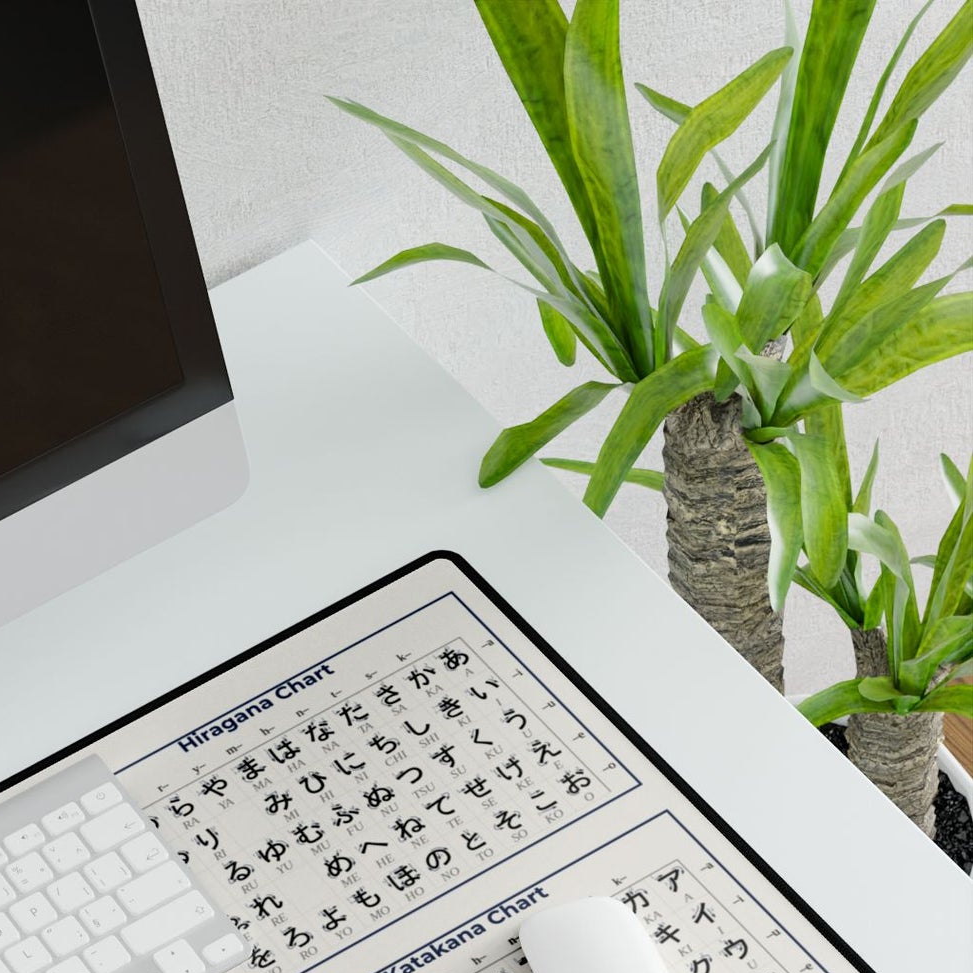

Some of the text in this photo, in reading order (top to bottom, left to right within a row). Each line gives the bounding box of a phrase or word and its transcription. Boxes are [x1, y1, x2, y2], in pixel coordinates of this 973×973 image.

[438, 648, 470, 670] あ
[407, 668, 436, 690] か
[376, 684, 402, 707] さ
[425, 684, 444, 698] KA
[470, 680, 499, 700] い
[177, 663, 336, 754] Hiragana Chart
[338, 704, 370, 727] た
[438, 698, 464, 718] き
[357, 722, 374, 734] TA
[403, 720, 431, 736] し
[503, 708, 527, 730] う
[304, 720, 335, 743] な
[418, 732, 440, 748] SHI
[470, 728, 494, 746] く
[267, 740, 301, 764] は
[321, 740, 340, 754] NA
[368, 735, 398, 755] ち
[531, 739, 562, 764] え
[287, 758, 306, 773] HA
[333, 752, 366, 776] に
[384, 750, 408, 767] CHI
[431, 745, 456, 768] す
[236, 757, 266, 780] ま
[396, 767, 423, 785] つ
[495, 758, 523, 781] け
[201, 778, 228, 797] や
[252, 776, 273, 791] MA
[298, 771, 327, 794] ひ
[411, 782, 436, 799] TSU
[463, 778, 492, 798] せ
[516, 776, 533, 791] KE
[560, 771, 591, 794] お
[169, 796, 195, 817] ら
[218, 798, 235, 811] YA
[264, 793, 293, 814] み
[319, 790, 335, 803] HI
[362, 787, 396, 808] ぬ
[425, 795, 455, 815] て
[530, 791, 558, 811] こ
[331, 803, 360, 827] ふ
[380, 803, 400, 818] NU
[495, 810, 522, 830] そ
[545, 808, 564, 824] KO
[182, 816, 201, 830] RA
[293, 822, 324, 844] む
[393, 818, 426, 841] ね
[195, 828, 219, 851] り
[310, 839, 331, 856] MU
[361, 841, 389, 855] へ
[461, 832, 487, 851] と
[213, 849, 227, 861] RI
[257, 840, 287, 863] ゆ
[376, 853, 396, 869] HE
[425, 847, 452, 871] の
[224, 860, 255, 882] る
[324, 855, 353, 877] め
[441, 866, 460, 882] NO
[241, 879, 260, 894] RU
[340, 872, 362, 888] ME
[386, 865, 421, 892] ほ
[657, 869, 680, 893] ア
[352, 890, 381, 908] も
[404, 886, 425, 902] HO
[623, 892, 650, 914] カ
[252, 896, 283, 917] れ
[369, 905, 391, 922] MO
[487, 885, 550, 925] Chart
[694, 902, 714, 924] イ
[322, 908, 347, 931] よ
[283, 926, 314, 948] ろ
[655, 925, 680, 944] キ
[250, 948, 276, 969] を
[299, 945, 319, 961] RO
[724, 939, 748, 960] ウ
